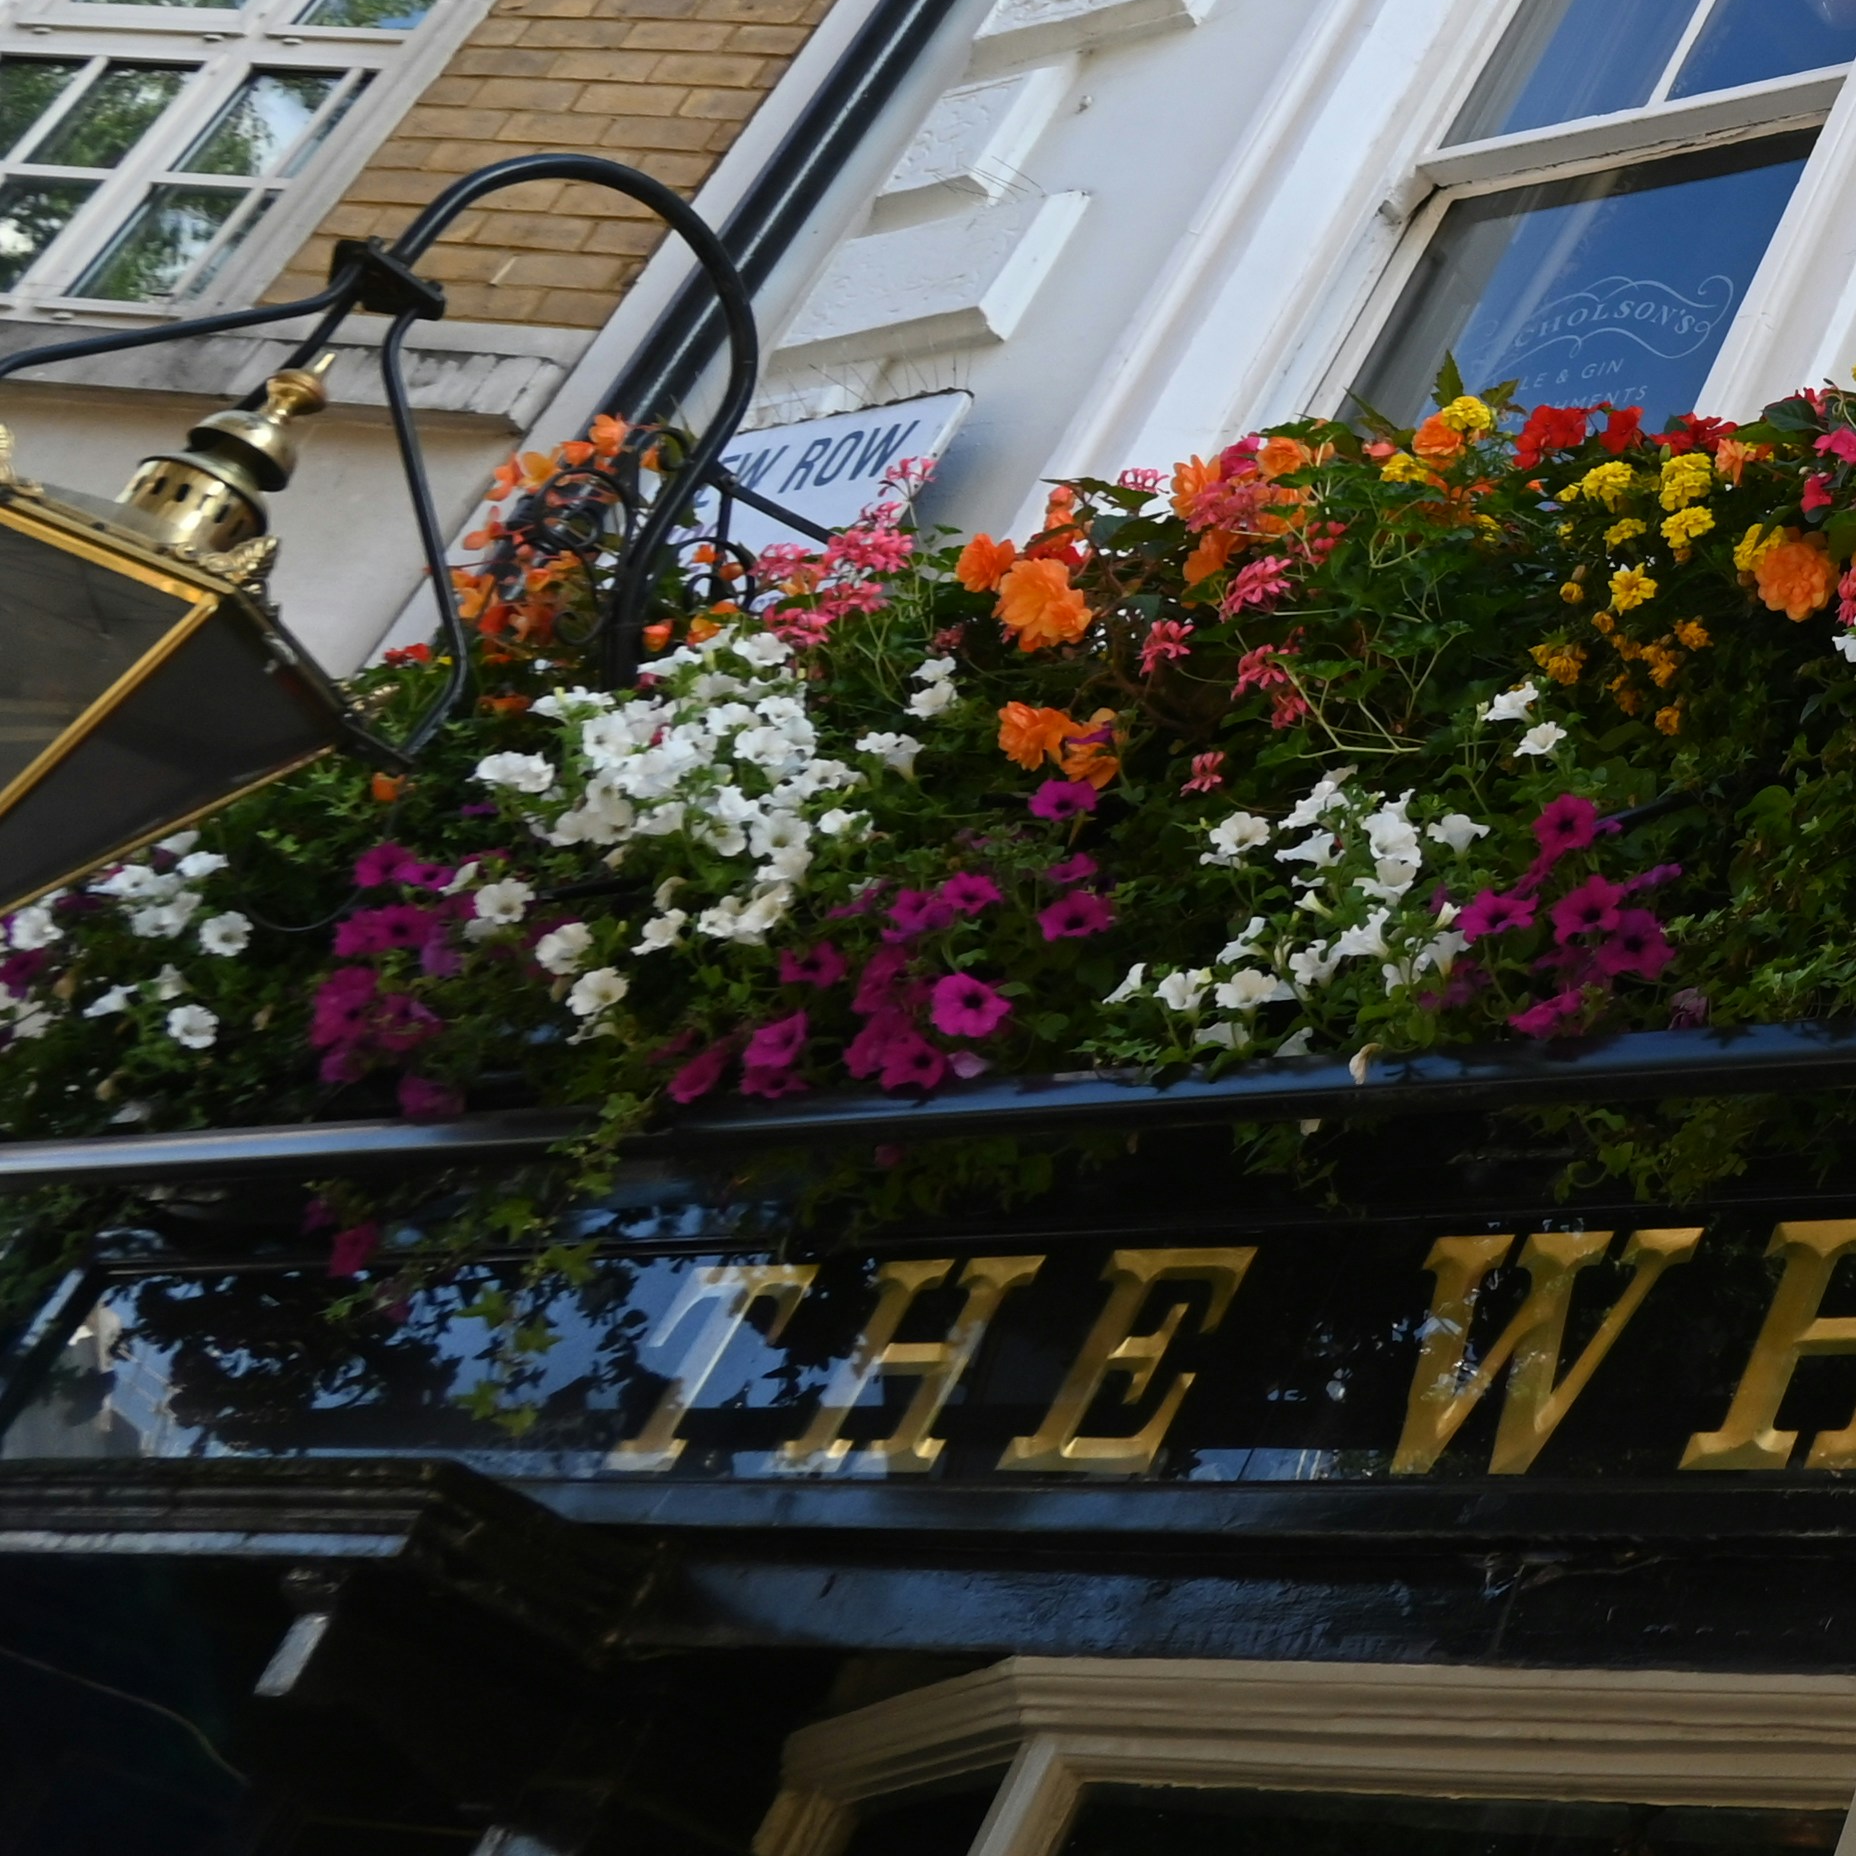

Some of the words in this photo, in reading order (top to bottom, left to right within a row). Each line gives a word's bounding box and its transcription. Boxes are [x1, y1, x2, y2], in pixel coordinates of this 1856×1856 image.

[1581, 359, 1623, 380] GIN
[778, 420, 921, 494] ROW
[610, 1246, 1258, 1474] THE
